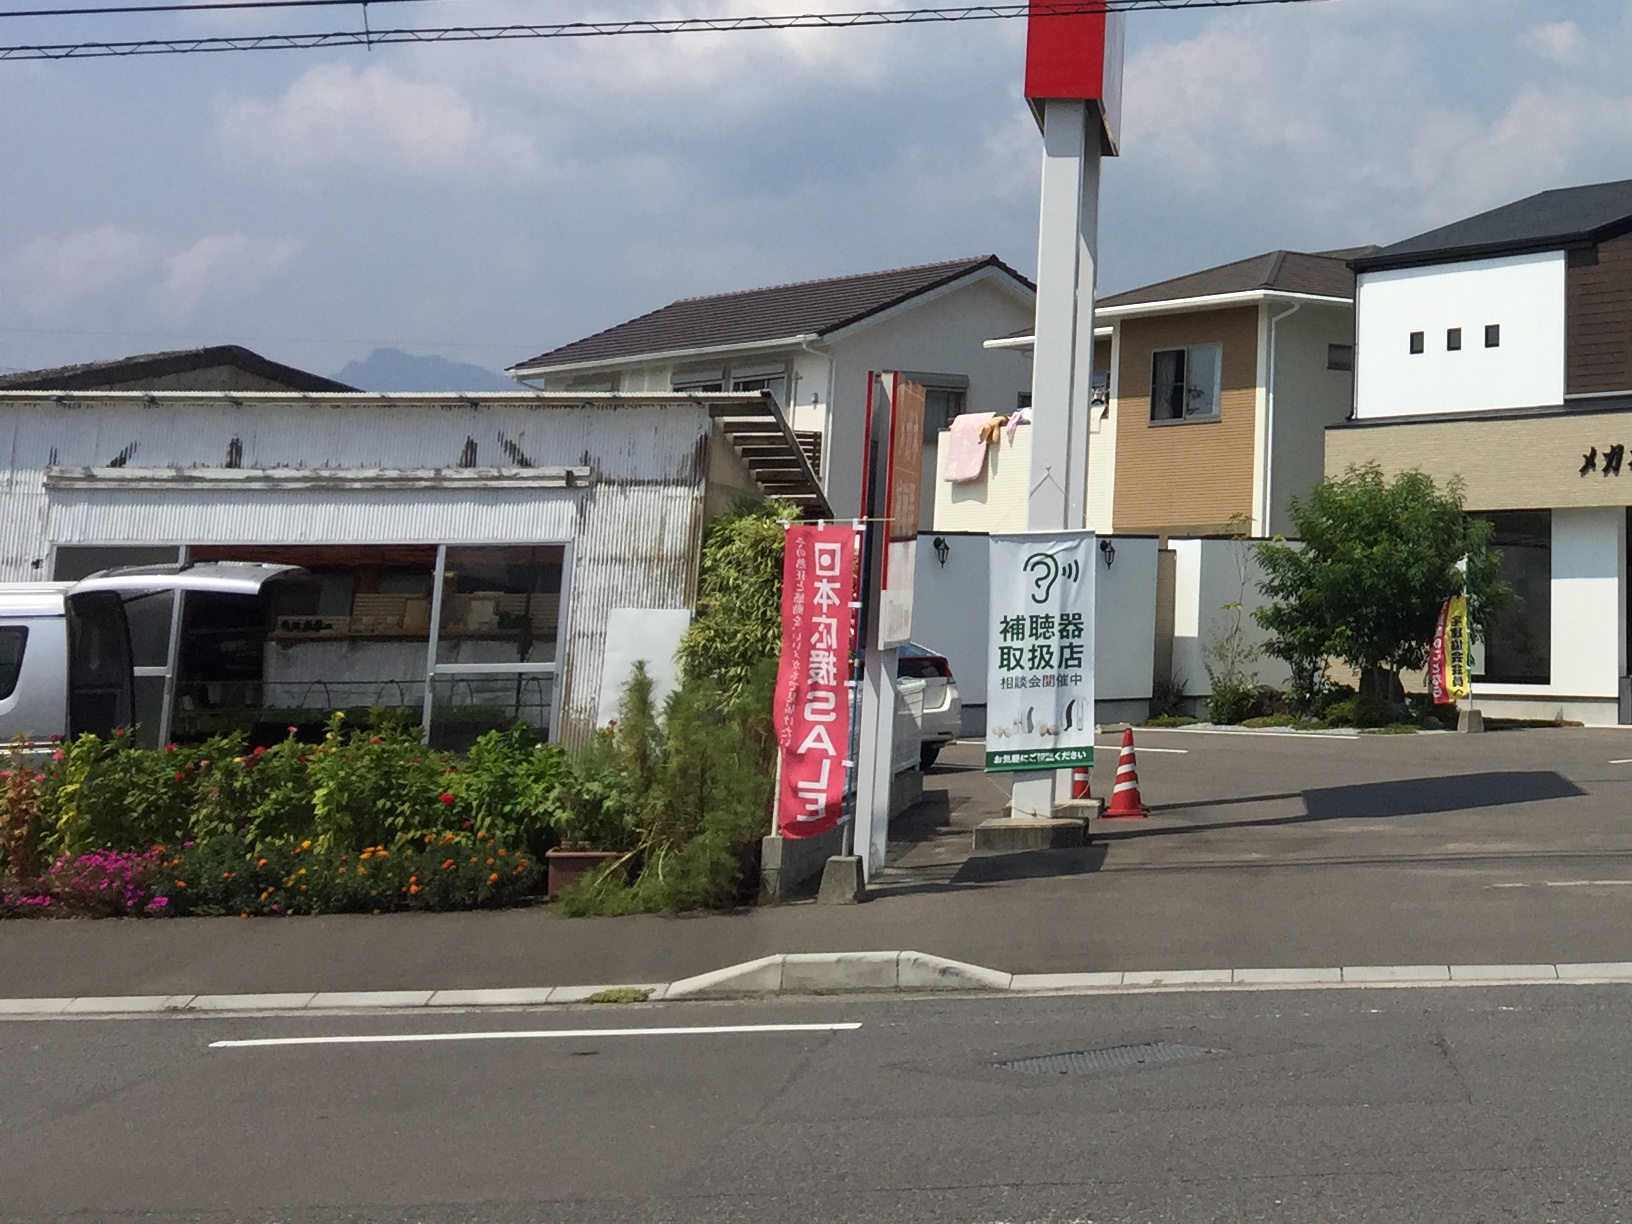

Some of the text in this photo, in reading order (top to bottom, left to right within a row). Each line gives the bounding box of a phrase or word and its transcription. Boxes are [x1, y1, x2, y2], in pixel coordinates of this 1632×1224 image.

[999, 613, 1085, 642] 補聴器
[998, 642, 1085, 672] 取扱店
[1000, 673, 1083, 690] 相談会開催中
